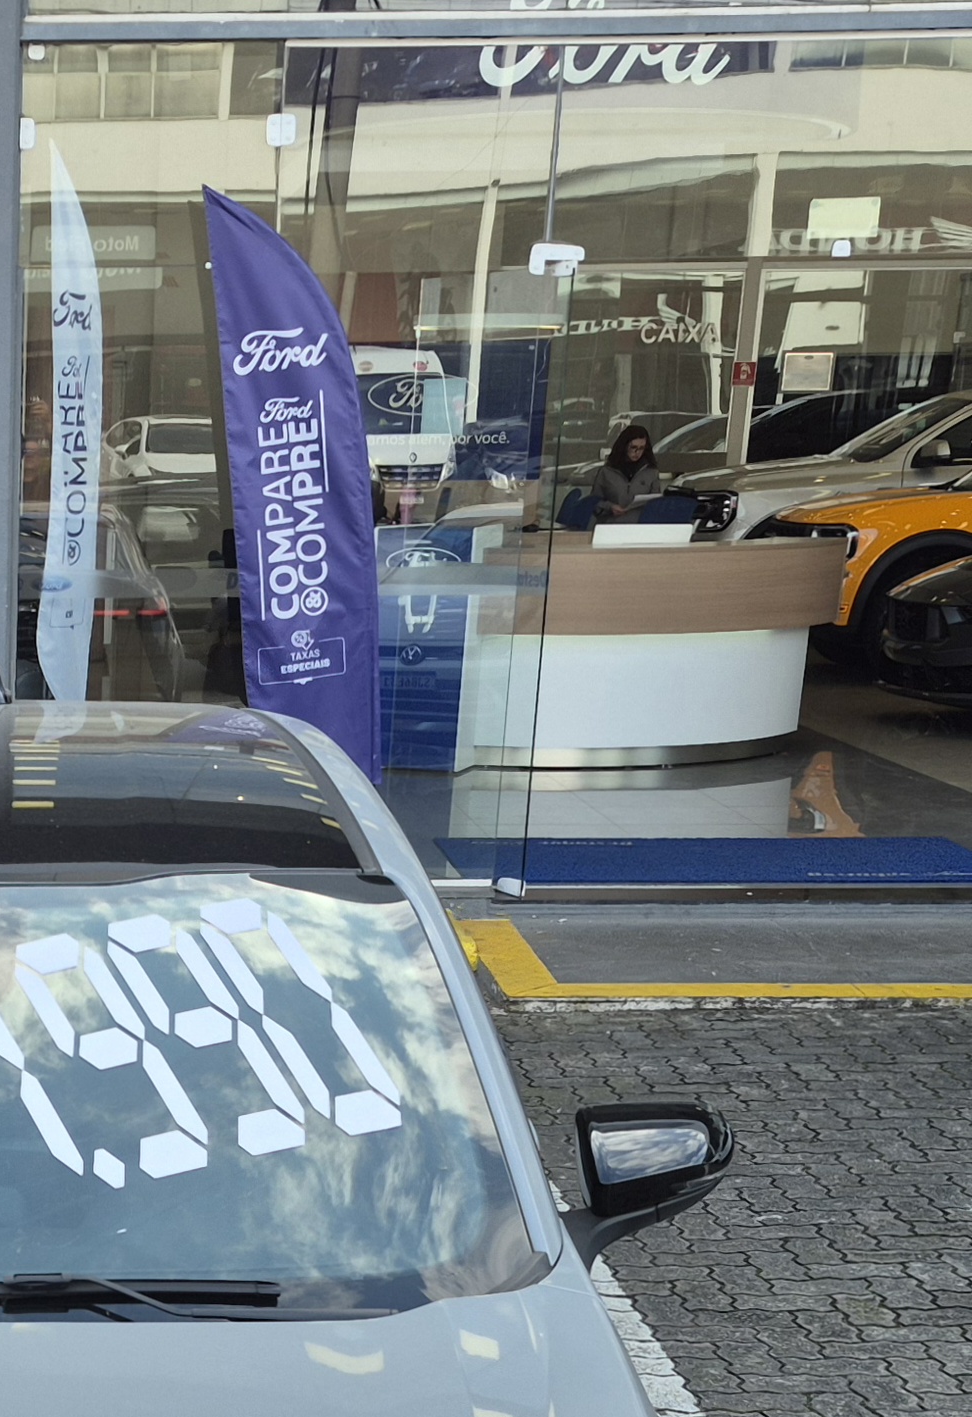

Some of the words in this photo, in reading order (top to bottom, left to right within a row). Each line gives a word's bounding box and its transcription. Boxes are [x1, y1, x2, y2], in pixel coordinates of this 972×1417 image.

[640, 321, 721, 344] CAIXA
[232, 326, 329, 377] Ford
[259, 396, 314, 424] Ford
[474, 430, 511, 445] você.
[257, 423, 300, 620] COMPARE
[280, 658, 331, 675] ESPECIAIS
[290, 649, 321, 662] TAXAS
